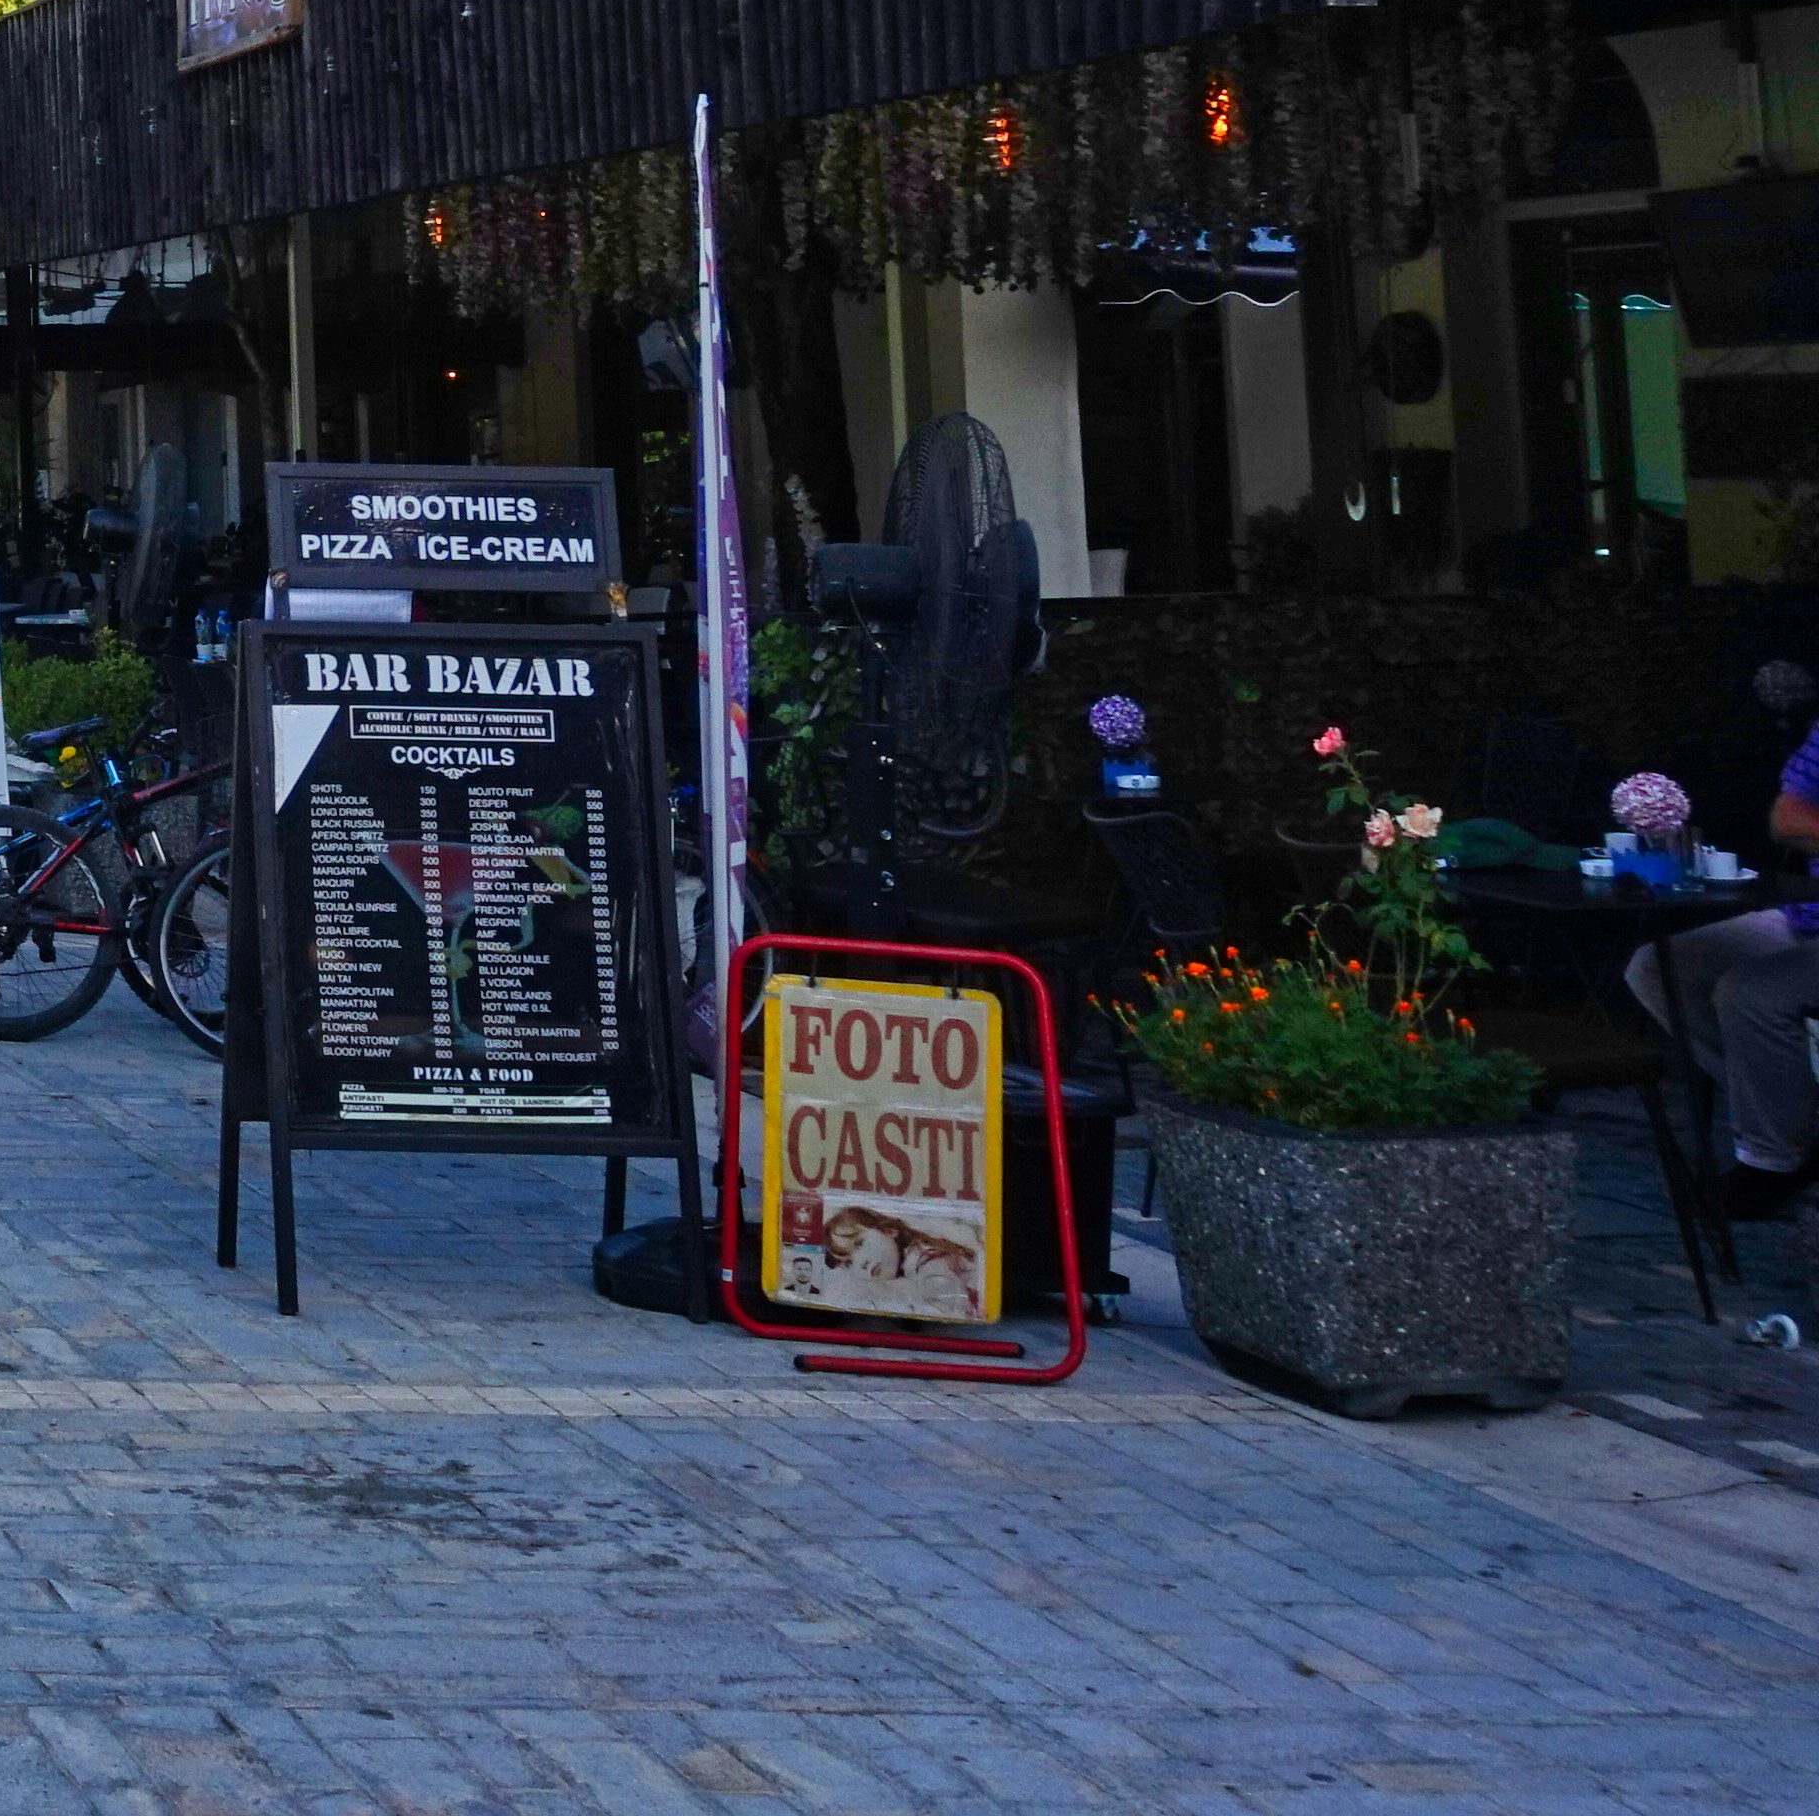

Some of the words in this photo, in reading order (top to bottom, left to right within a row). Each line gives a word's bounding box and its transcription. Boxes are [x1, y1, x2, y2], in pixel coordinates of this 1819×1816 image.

[350, 494, 537, 524] SMOOTHIES
[300, 534, 393, 561] PIZZA
[417, 535, 595, 564] ICE-CREAM
[304, 653, 411, 694] BAR
[425, 654, 595, 697] BAZAR
[366, 711, 404, 721] COFFEE
[413, 713, 438, 722] SOFT
[440, 713, 479, 723] DRINKS
[485, 714, 543, 724] SMOOTHIES
[358, 724, 413, 734] ALCOHOLIC
[414, 725, 447, 734] DRINK
[455, 726, 481, 736] BEER
[489, 727, 513, 736] VINE
[520, 727, 546, 736] RAKI
[391, 746, 515, 766] COCKTAILS
[311, 785, 342, 793] SHOTS
[420, 786, 436, 794] 150
[468, 787, 504, 796] MOJITO
[506, 788, 534, 796] FRUIT
[420, 798, 437, 806] 300
[469, 799, 508, 808] DESPER
[311, 808, 337, 816] LONG
[339, 808, 374, 817] DRINKS
[420, 810, 437, 818] 350
[469, 811, 516, 820] ELEONOR
[311, 820, 341, 828] BLACK
[343, 820, 384, 828] RUSSIAN
[470, 823, 509, 832] JOSHUA
[311, 832, 348, 840] APEROL
[350, 832, 383, 840] SPRITZ
[421, 833, 438, 842] 450
[471, 834, 493, 843] PINA
[494, 835, 534, 843] COLADA
[311, 843, 353, 852] CAMPARI
[355, 844, 389, 852] SPRITZ
[471, 846, 523, 855] ESPRESSO
[525, 847, 565, 856] MARTINI
[589, 849, 606, 857] 500
[312, 855, 345, 864] VODKA
[346, 856, 379, 864] SOURS
[422, 857, 439, 865] 500
[471, 858, 489, 866] GIN
[313, 867, 367, 875] MARGARITA
[423, 869, 440, 877] 500
[472, 870, 515, 879] ORGASM
[423, 881, 441, 889] 500
[473, 882, 493, 890] SEX
[494, 882, 509, 891] ON
[511, 883, 530, 892] THE
[533, 883, 566, 892] BEACH
[314, 891, 349, 899] MOJITO
[425, 892, 442, 901] 500
[474, 894, 525, 903] SWIMMING
[527, 895, 554, 904] POOL
[314, 902, 354, 911] TEQUILA
[355, 903, 397, 912] SUNRISE
[475, 906, 515, 915] FRENCH
[315, 914, 332, 923] GIN
[334, 915, 354, 923] FIZZ
[475, 918, 521, 927] NEGRONI
[316, 926, 341, 935] CUBA
[343, 927, 370, 936] LIBRE
[476, 930, 497, 938] AMF
[316, 939, 353, 947] GINGER
[355, 939, 402, 948] COCKTAIL
[427, 941, 444, 949] 500
[477, 942, 511, 951] ENZOS
[317, 950, 345, 959] HUGO
[429, 953, 445, 961] 500
[523, 955, 550, 964] MULE
[318, 962, 358, 972] LONDON
[359, 963, 382, 972] NEW
[429, 965, 446, 973] 500
[479, 966, 498, 975] BLU
[499, 966, 534, 976] LAGON
[319, 975, 335, 983] MAI
[337, 975, 351, 983] TAI
[480, 978, 486, 987] 5
[488, 979, 522, 988] VODKA
[319, 986, 394, 996] COSMOPOLITAN
[481, 990, 509, 1000] LONG
[510, 991, 552, 1000] ISLANDS
[320, 999, 377, 1008] MANHATTAN
[482, 1002, 502, 1012] HOT
[504, 1003, 529, 1012] WINE
[321, 1011, 379, 1020] CAIPIROSKA
[322, 1023, 368, 1032] FLOWERS
[514, 1027, 539, 1036] STAR
[541, 1028, 581, 1037] MARTINI
[323, 1035, 349, 1044] DARK
[323, 1047, 362, 1056] BLOODY
[364, 1048, 392, 1057] MARY
[789, 1004, 980, 1090] FOTO
[485, 1051, 533, 1061] COCKTAIL
[535, 1052, 550, 1061] ON
[552, 1052, 597, 1062] REQUEST
[413, 1066, 464, 1081] PIZZA
[469, 1068, 482, 1081] &
[488, 1068, 534, 1082] FOOD
[787, 1105, 981, 1201] CASTI
